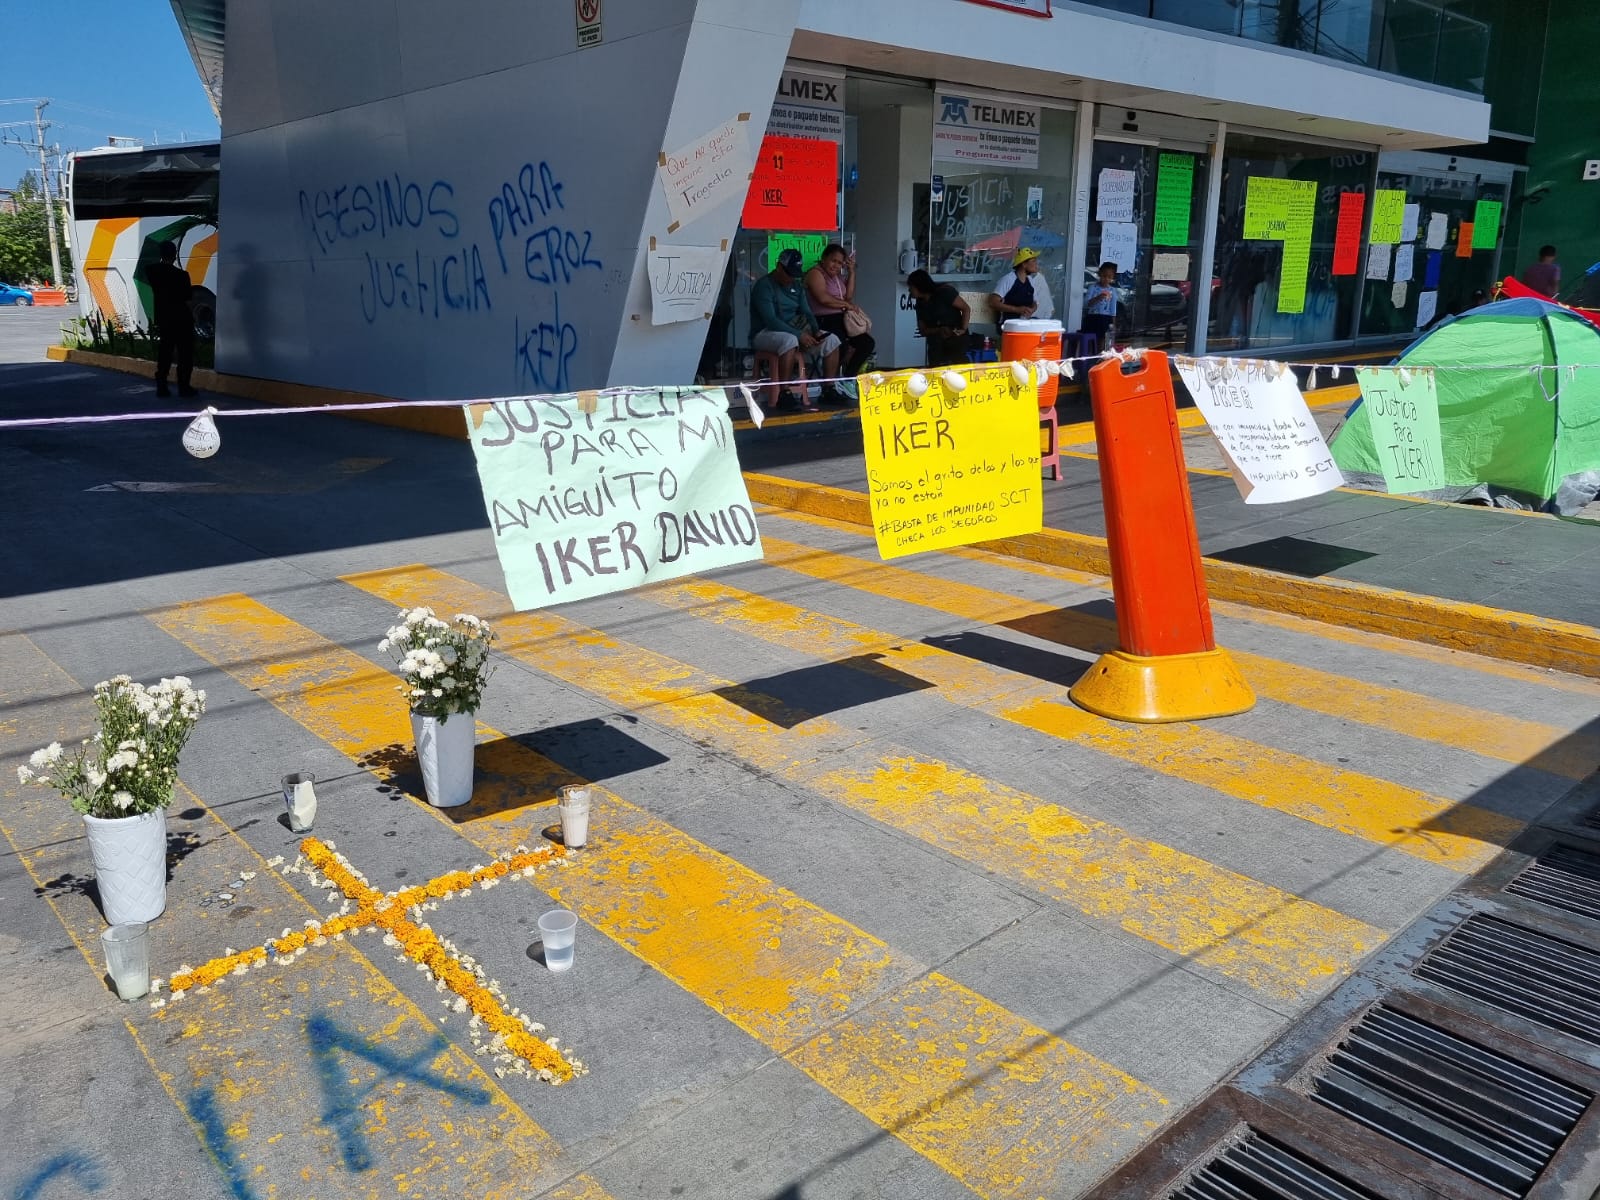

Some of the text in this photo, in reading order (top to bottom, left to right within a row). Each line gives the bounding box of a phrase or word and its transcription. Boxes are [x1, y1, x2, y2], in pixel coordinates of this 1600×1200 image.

[779, 78, 838, 102] LMEX
[793, 111, 819, 122] paquete
[972, 105, 1036, 128] TELMEX
[955, 149, 999, 159] Pregunta
[681, 168, 733, 208] Tragedia
[762, 188, 784, 204] IKER
[488, 161, 566, 274] PARA
[360, 244, 491, 325] JUSTICIA
[656, 255, 712, 296] JUSTICIA
[930, 392, 994, 419] JUSTICIA
[1210, 384, 1254, 410] IKER
[540, 414, 728, 476] PARA MI
[878, 419, 956, 460] IKER
[869, 469, 913, 493] Somos
[918, 470, 929, 486] el
[934, 465, 964, 491] grito
[1305, 459, 1334, 478] SCT
[878, 487, 1031, 537] #BASTA DE IMPUNIDAD SCT
[894, 494, 906, 505] no
[896, 513, 998, 548] CHECA LOS SEGUROS
[535, 503, 757, 594] IKER DAVID
